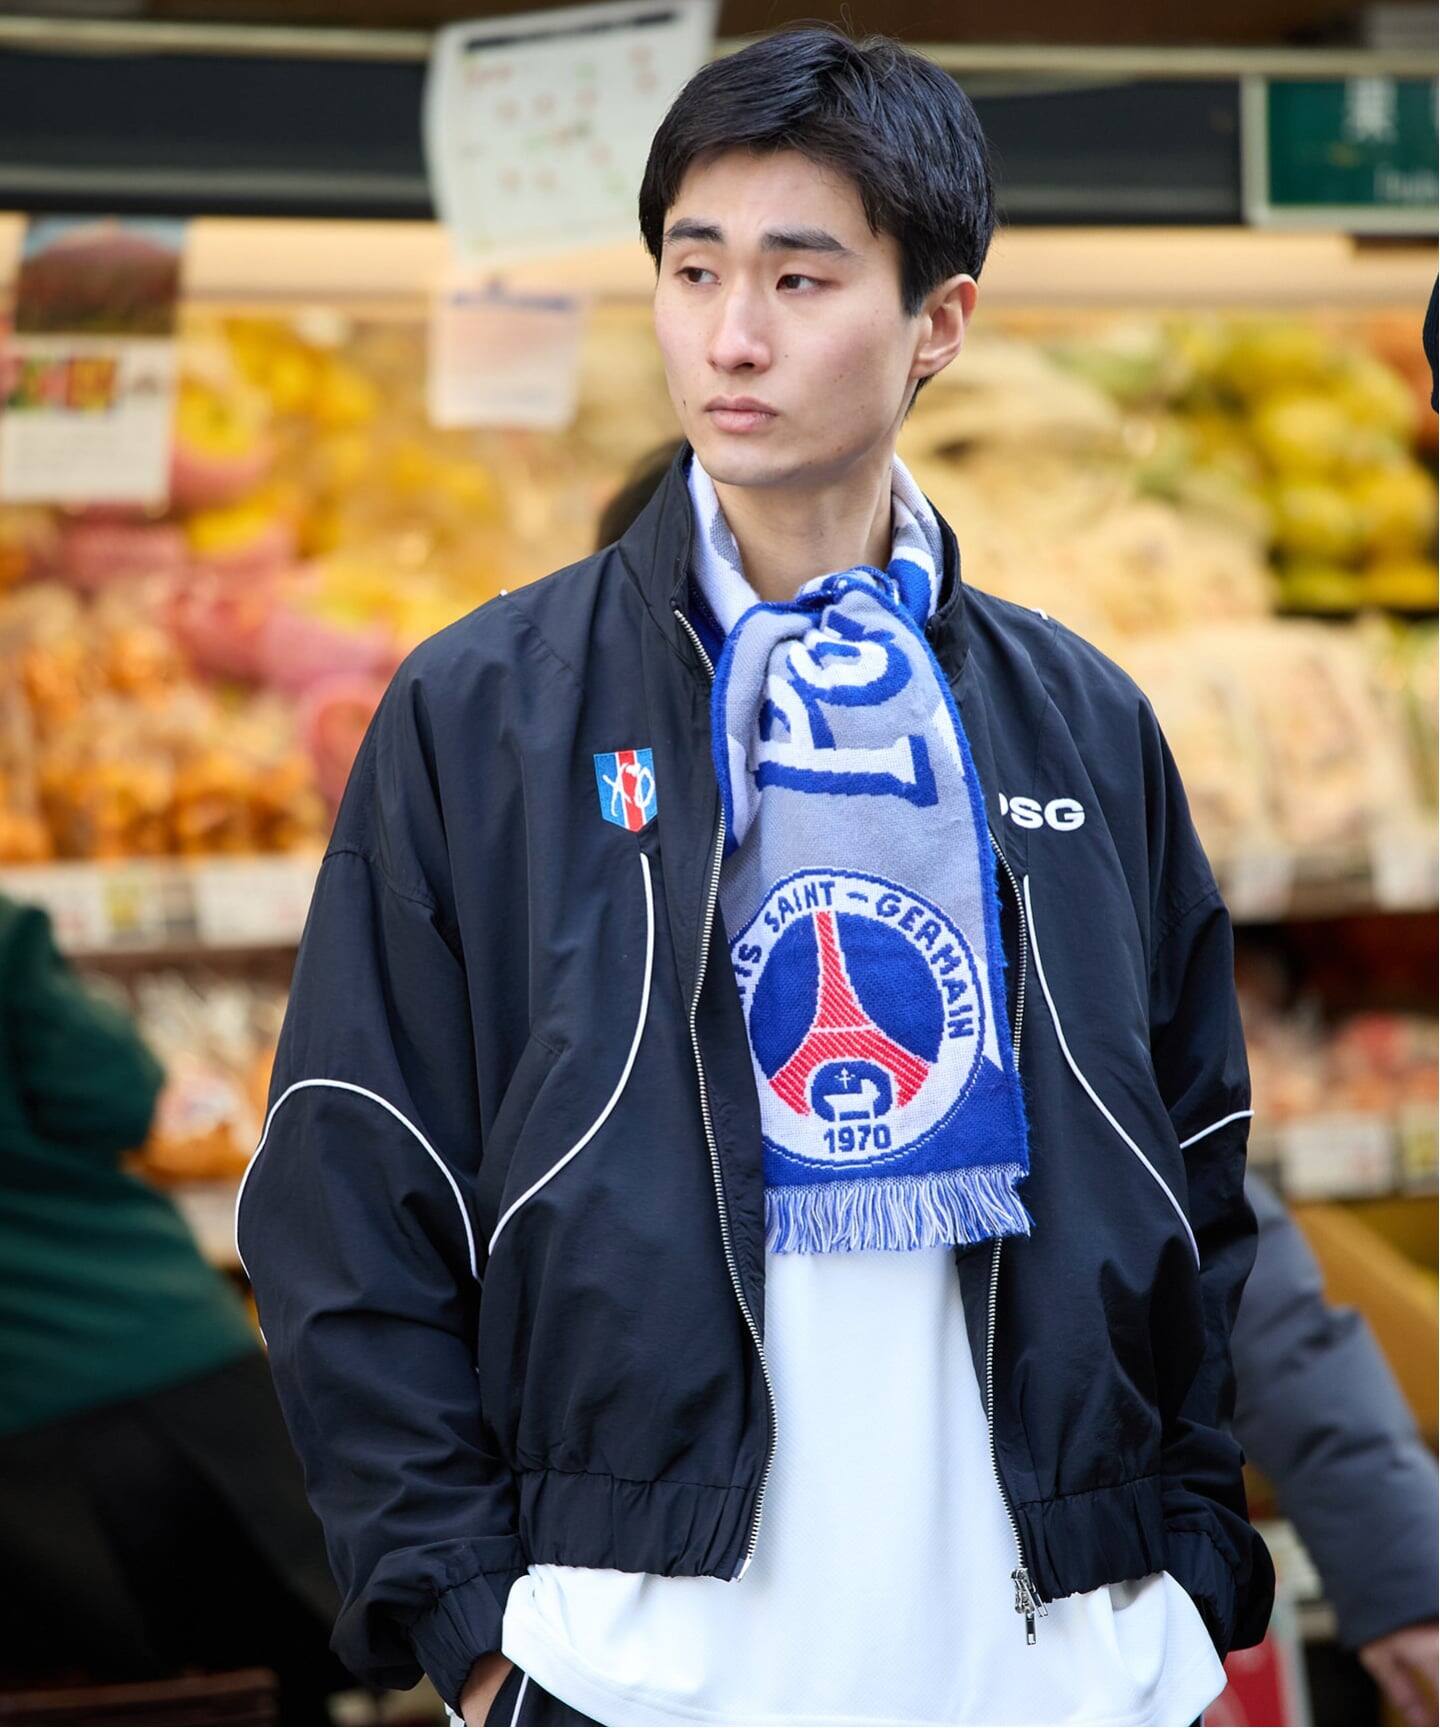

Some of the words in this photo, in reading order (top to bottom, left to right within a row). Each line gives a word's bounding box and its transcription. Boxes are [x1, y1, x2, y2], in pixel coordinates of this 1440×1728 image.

[764, 881, 835, 933] SAINT
[876, 893, 974, 1039] GERMAIN
[824, 1124, 892, 1153] 1970
